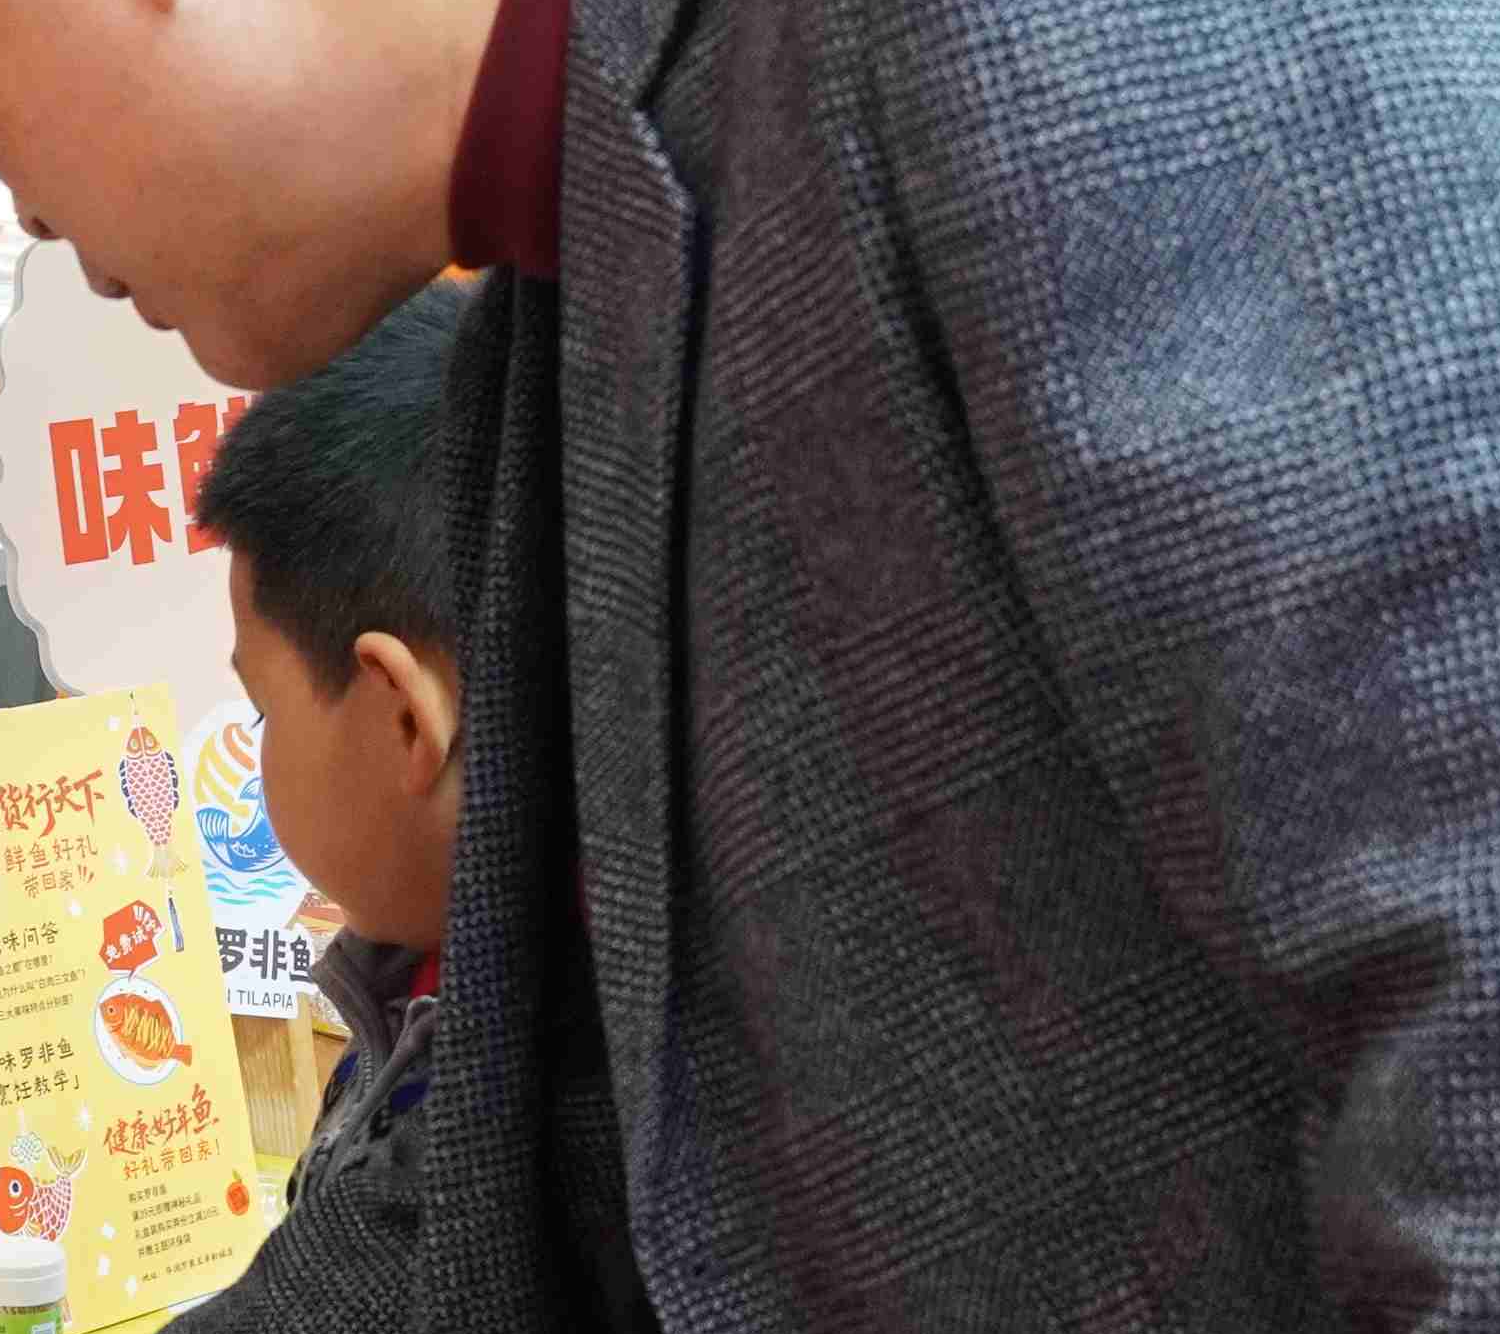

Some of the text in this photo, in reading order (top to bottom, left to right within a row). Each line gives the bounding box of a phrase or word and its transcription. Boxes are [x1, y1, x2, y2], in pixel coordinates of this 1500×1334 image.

[2, 835, 98, 873] 鲜鱼好礼
[236, 989, 294, 1009] TILAPIA
[103, 1083, 220, 1156] 健康好年鱼
